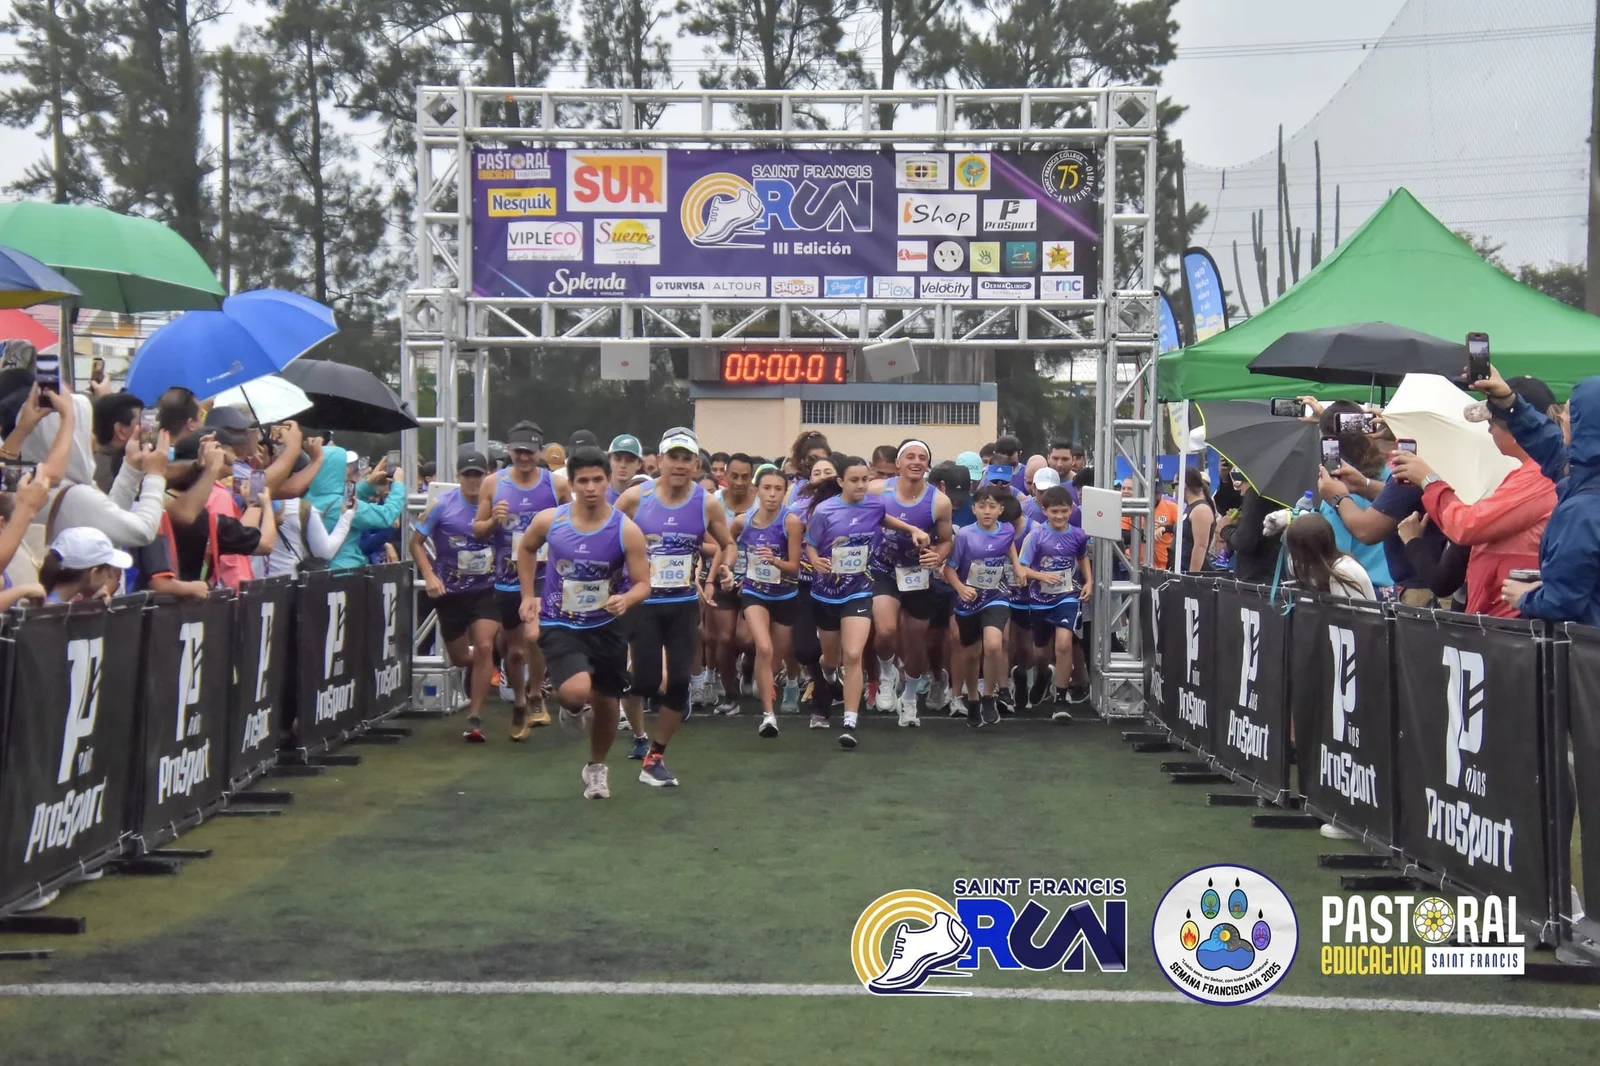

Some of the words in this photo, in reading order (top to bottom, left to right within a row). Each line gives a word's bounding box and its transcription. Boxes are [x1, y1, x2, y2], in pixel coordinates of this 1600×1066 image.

[477, 152, 551, 170] PASTORAL
[752, 164, 799, 178] SAINT
[803, 164, 873, 178] FRANCIS
[573, 165, 655, 204] SUR
[1057, 165, 1079, 189] 75
[1057, 165, 1095, 204] ANIVERSARIO
[492, 193, 553, 214] Nesquik
[753, 178, 873, 232] RUN
[596, 221, 655, 245] Suerre
[985, 221, 1034, 231] ProSport
[509, 231, 576, 246] VIPLECO
[772, 242, 789, 255] III
[793, 241, 852, 255] Edición
[548, 268, 627, 296] Splenda
[664, 281, 705, 290] TURVISA
[713, 281, 761, 290] ALTOUR
[921, 278, 970, 297] Velocity
[1055, 279, 1082, 292] rnc
[839, 559, 862, 567] 140
[659, 570, 685, 580] 186
[1227, 709, 1269, 761] ProSport
[158, 738, 210, 804] ProSport
[1319, 743, 1378, 808] ProSport
[24, 776, 107, 863] ProSport
[1425, 787, 1514, 873] ProSport
